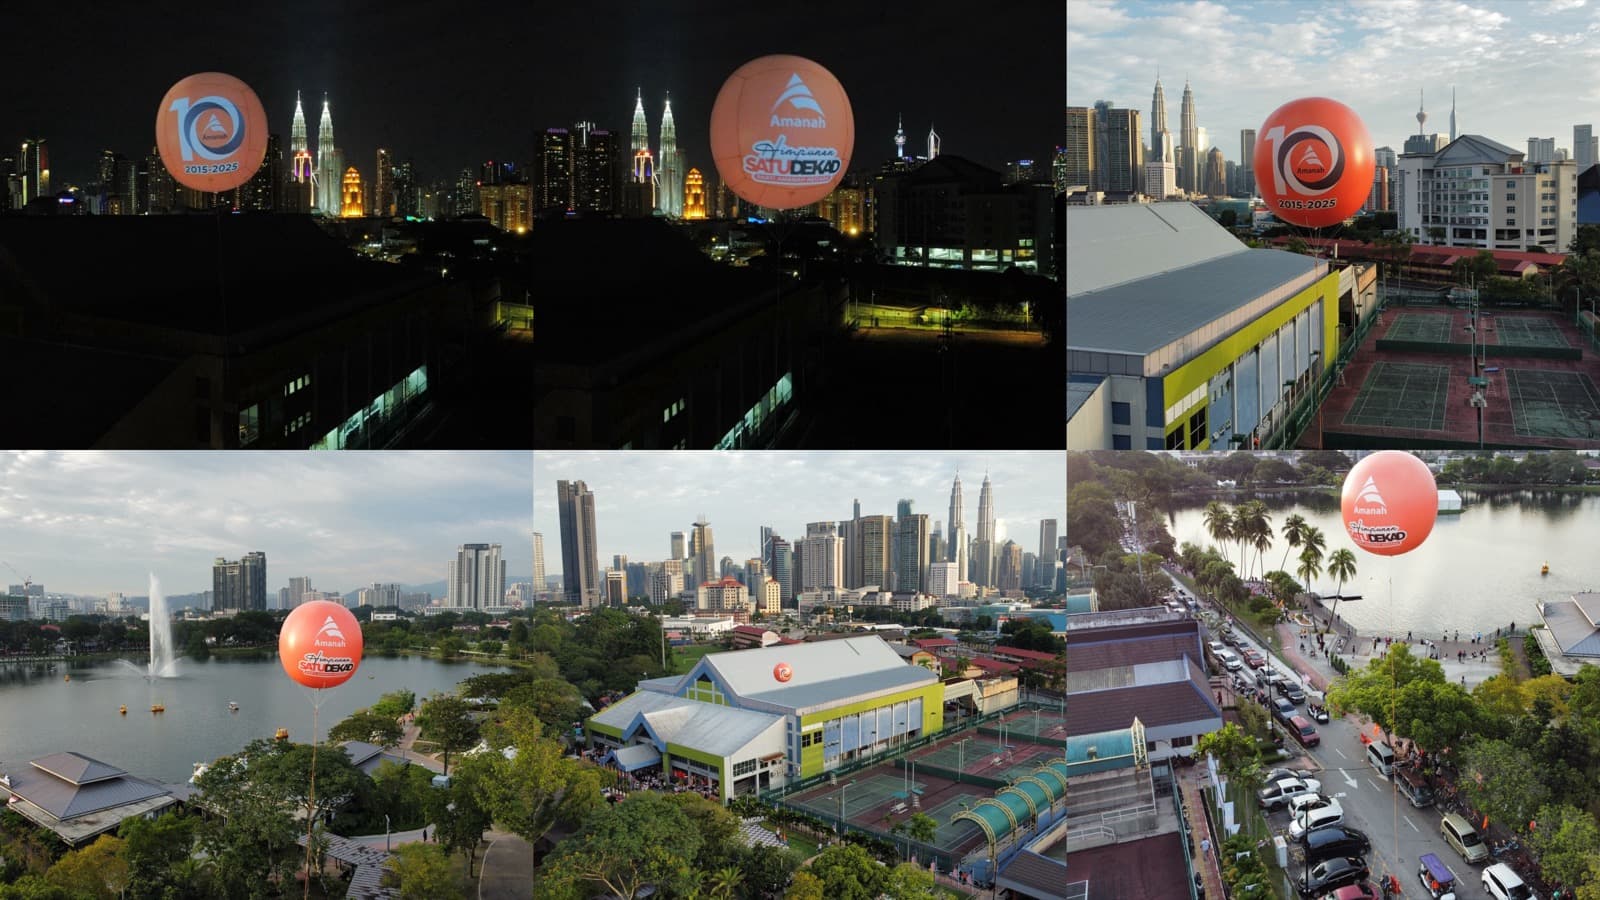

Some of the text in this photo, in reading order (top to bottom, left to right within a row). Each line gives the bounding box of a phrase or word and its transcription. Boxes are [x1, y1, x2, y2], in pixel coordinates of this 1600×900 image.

[770, 114, 826, 128] Amanah
[169, 96, 245, 161] 10
[1264, 125, 1345, 195] 10
[185, 163, 238, 174] 2015-2025
[1279, 199, 1337, 210] 2015-2025
[1353, 506, 1388, 516] Amanah
[314, 639, 347, 648] Amanah
